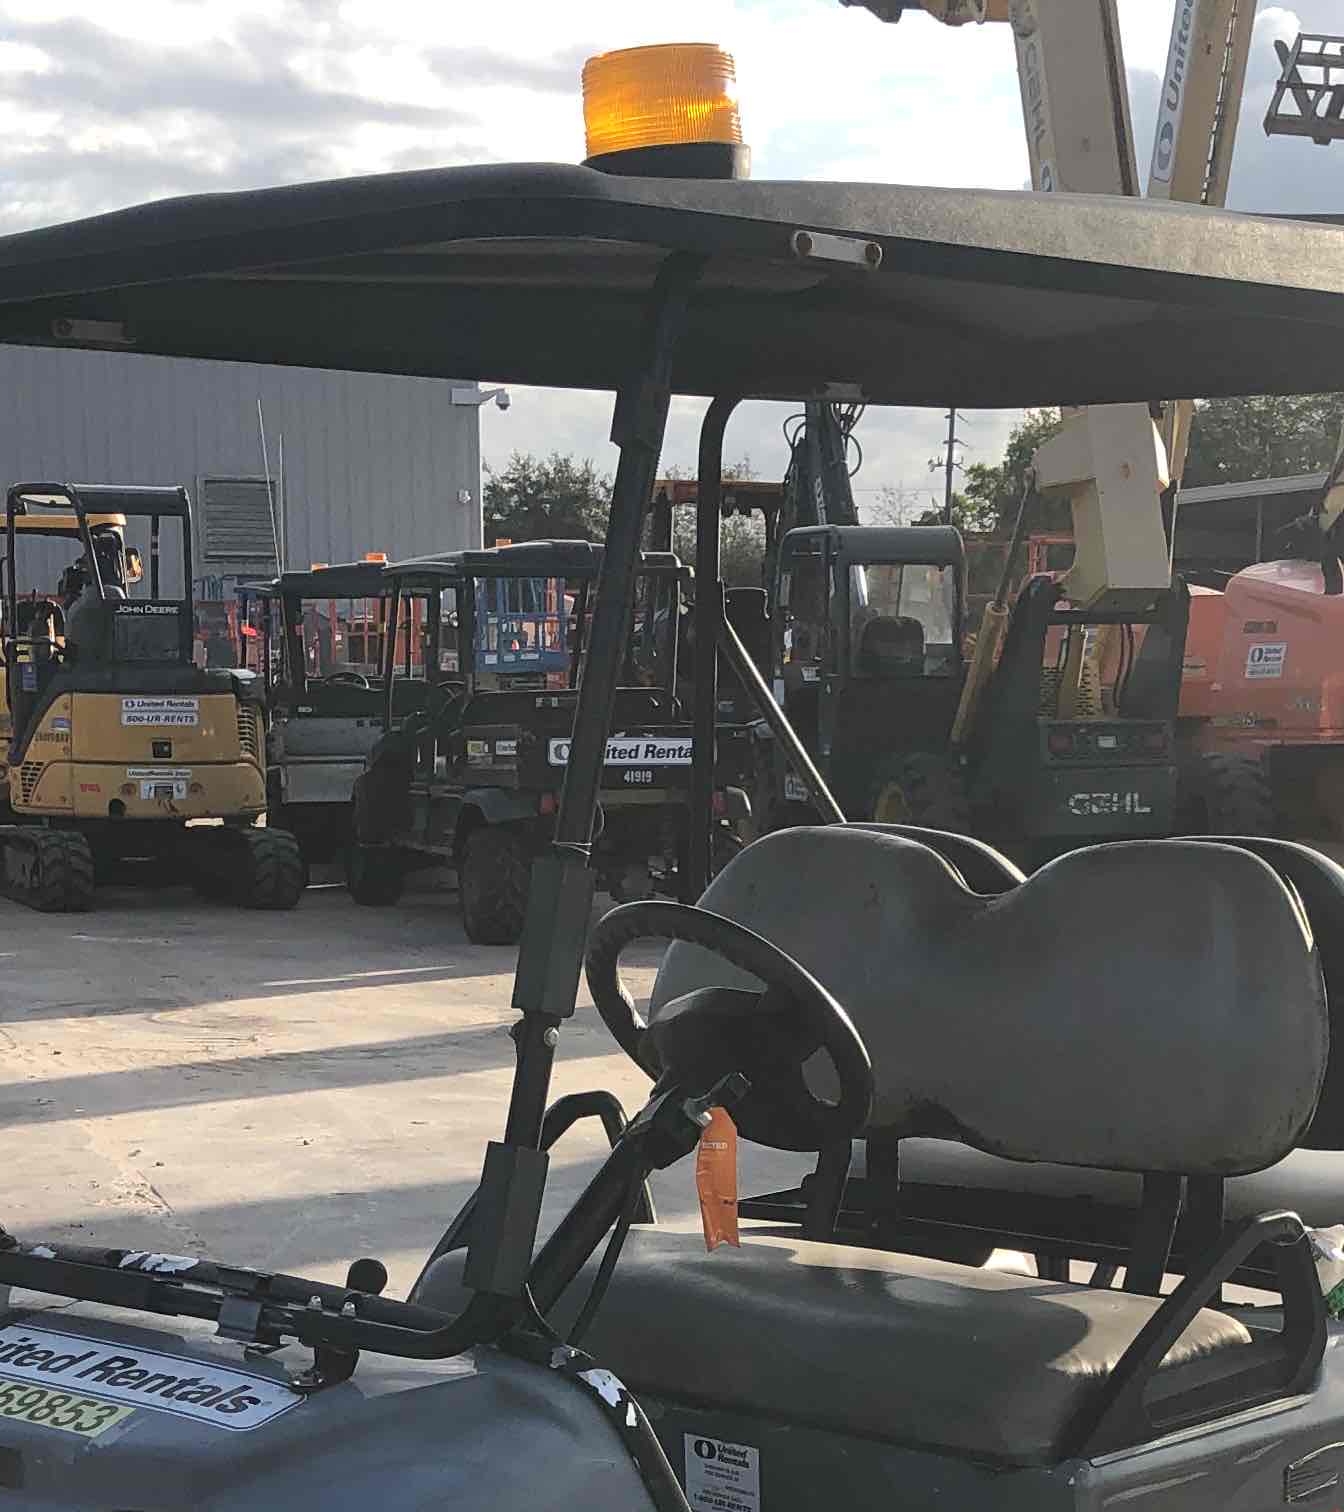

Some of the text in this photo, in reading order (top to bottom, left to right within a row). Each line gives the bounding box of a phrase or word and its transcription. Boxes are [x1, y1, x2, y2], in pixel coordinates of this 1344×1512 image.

[115, 603, 179, 614] JOHN DEERE
[606, 743, 693, 760] ited Renta
[1068, 791, 1153, 816] GEHL
[73, 1349, 262, 1414] Rentals
[718, 1443, 748, 1458] United
